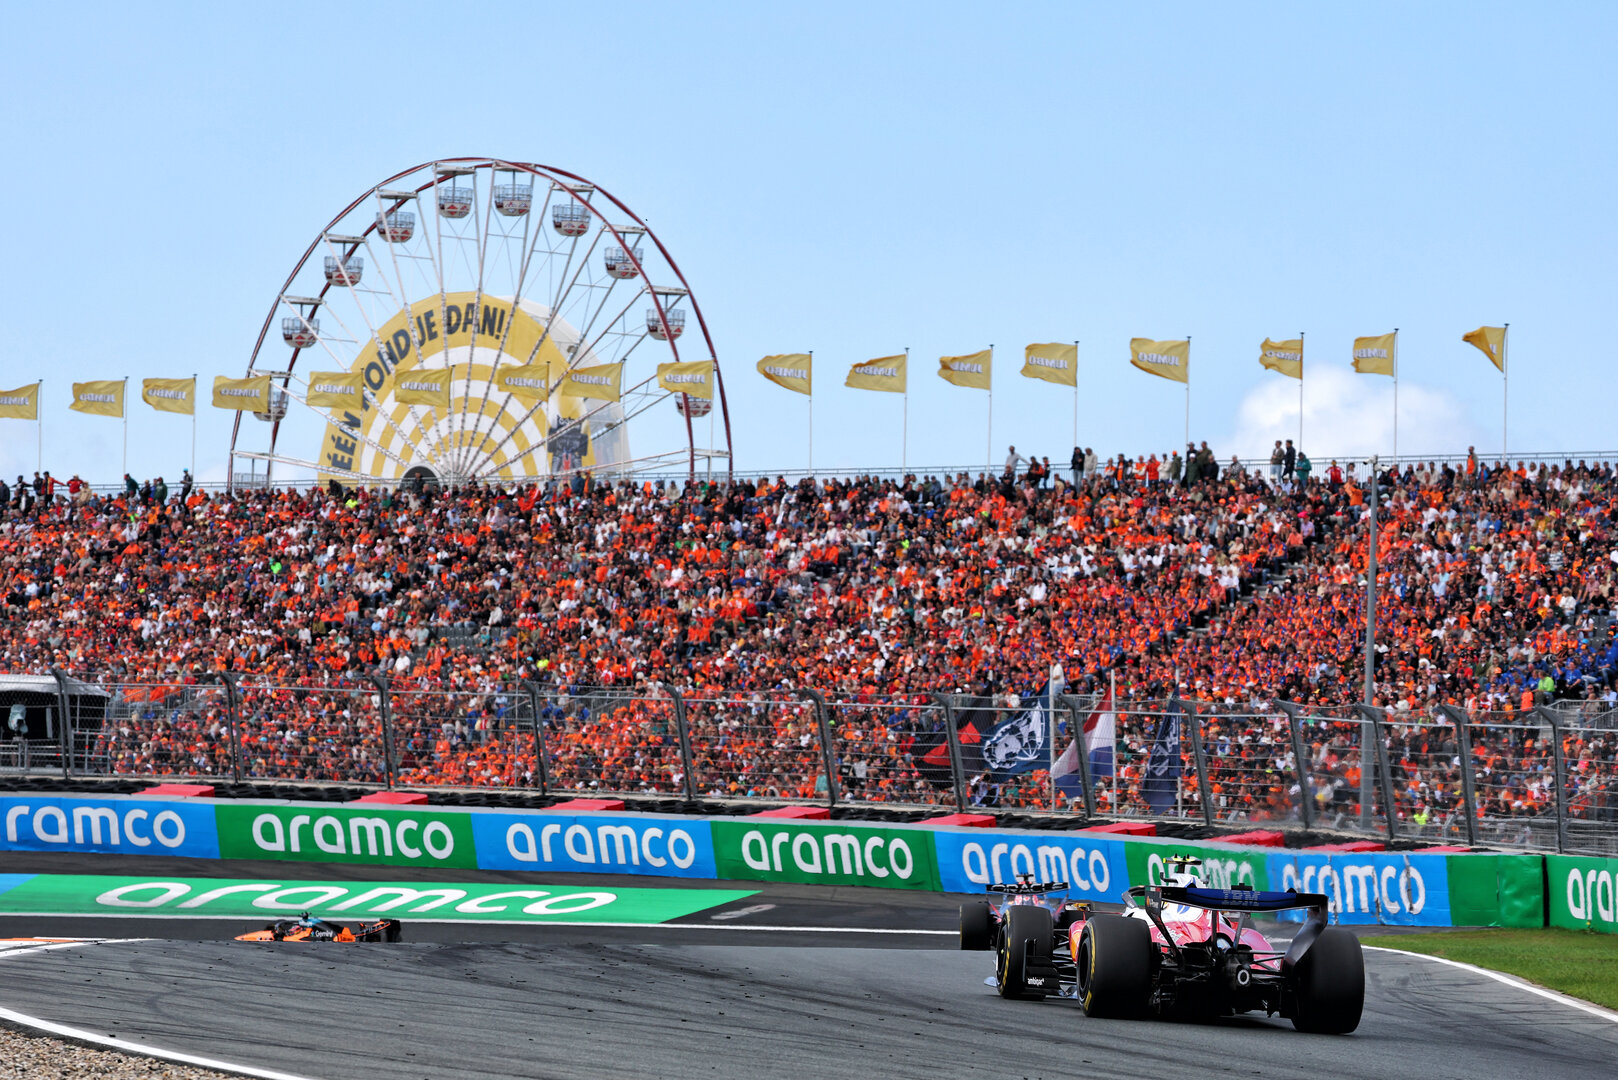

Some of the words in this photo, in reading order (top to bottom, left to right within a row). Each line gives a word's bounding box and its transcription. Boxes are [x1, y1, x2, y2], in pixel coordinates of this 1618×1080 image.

[444, 303, 505, 340] DAN!
[6, 805, 186, 848] ramco
[252, 813, 454, 859] aramco
[506, 823, 695, 869] aramco
[742, 830, 913, 879] aramco
[962, 842, 1110, 892] aramco
[96, 882, 617, 915] aramco
[991, 882, 1064, 893] ORACLE
[1283, 864, 1426, 914] aramco
[1567, 868, 1618, 922] ara
